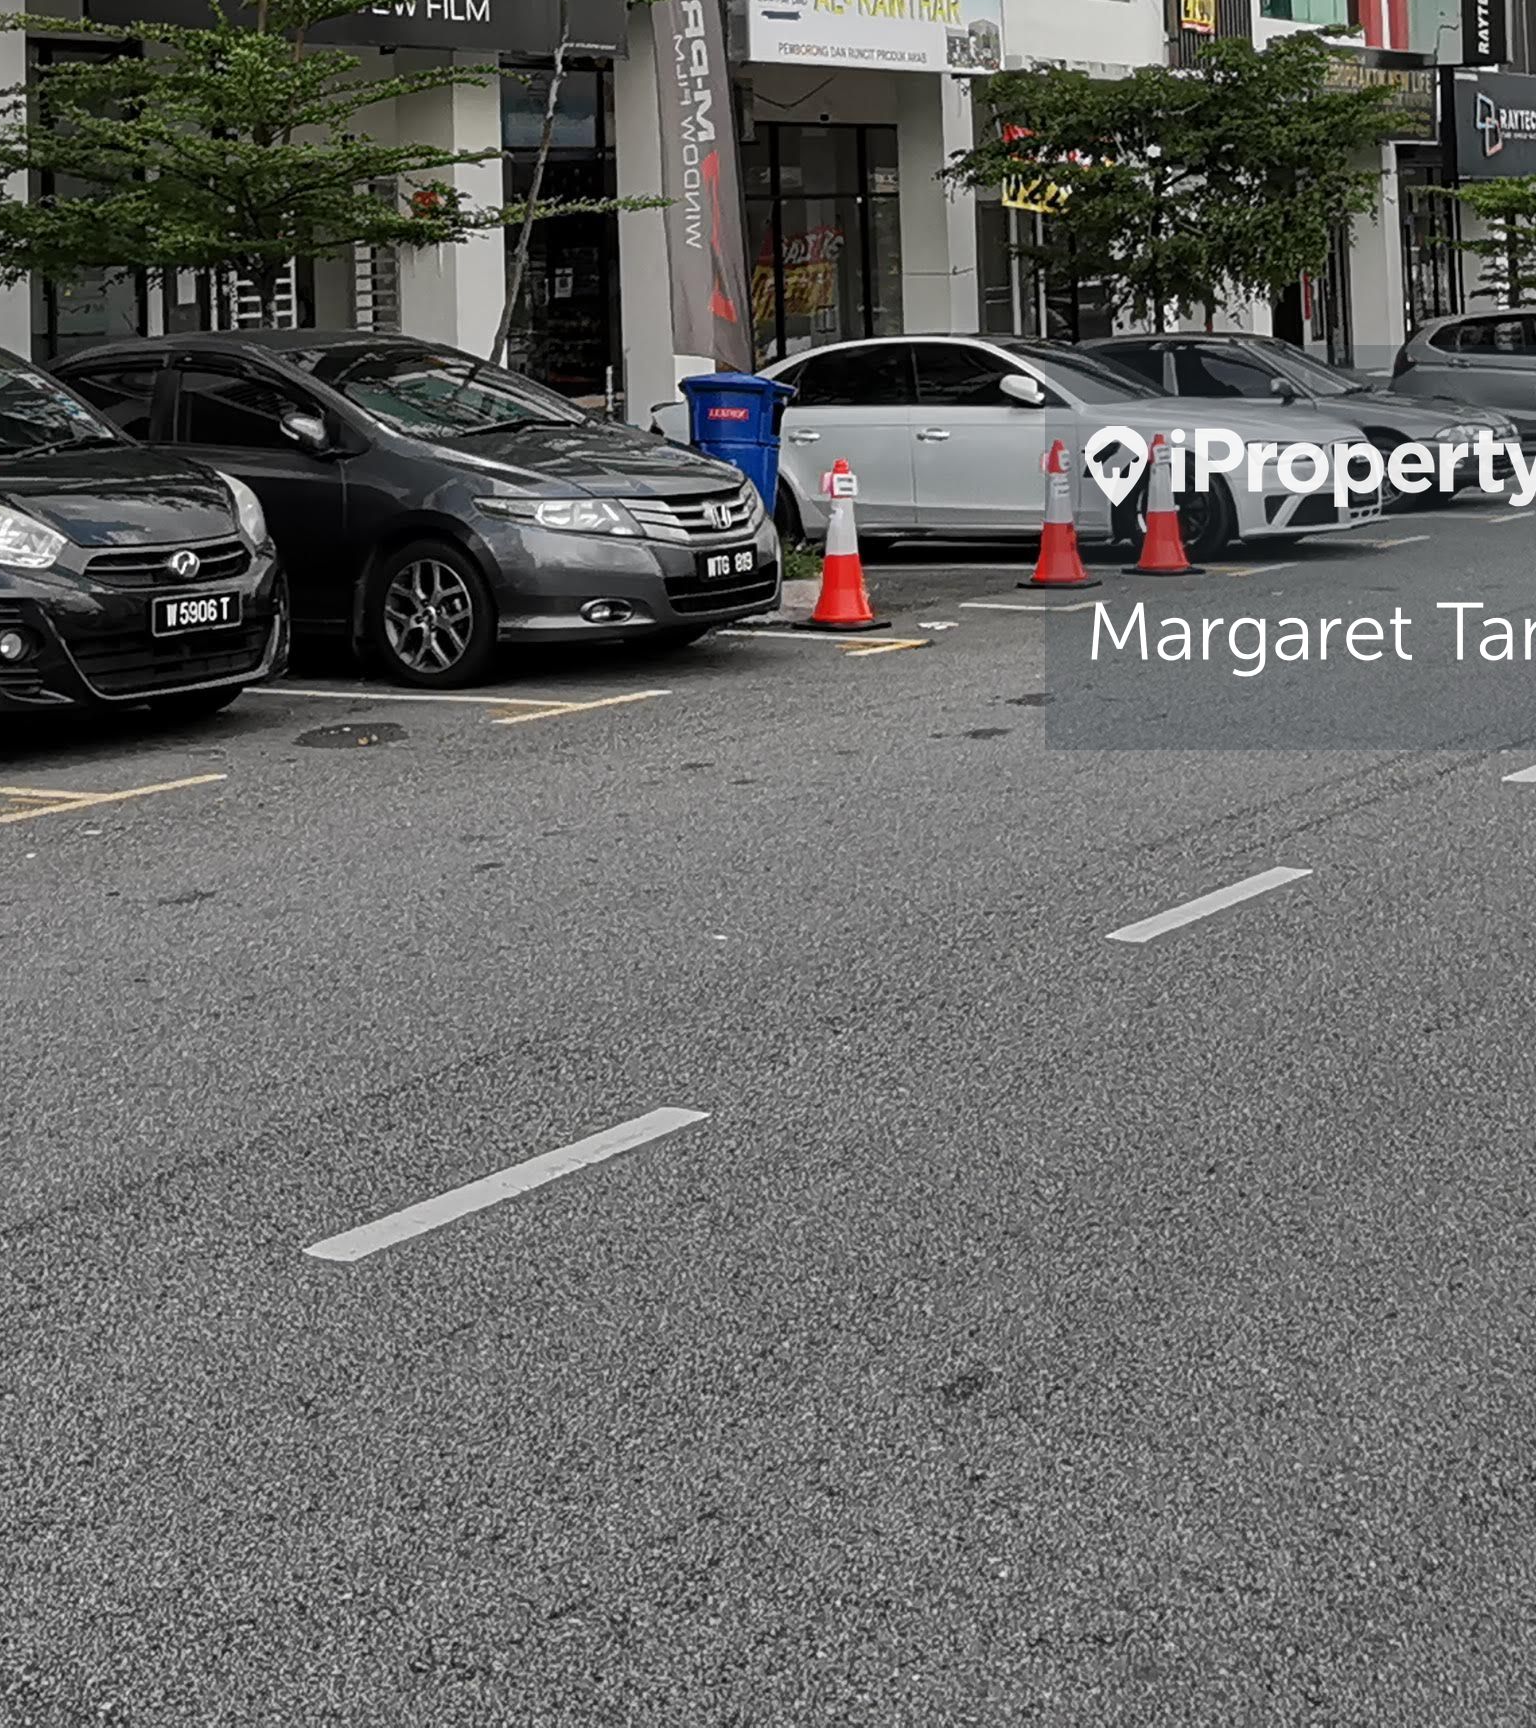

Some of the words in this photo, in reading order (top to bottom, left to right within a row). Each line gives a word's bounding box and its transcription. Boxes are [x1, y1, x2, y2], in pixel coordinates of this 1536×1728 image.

[830, 46, 846, 58] DAN
[179, 598, 218, 625] 5906
[219, 596, 231, 621] T
